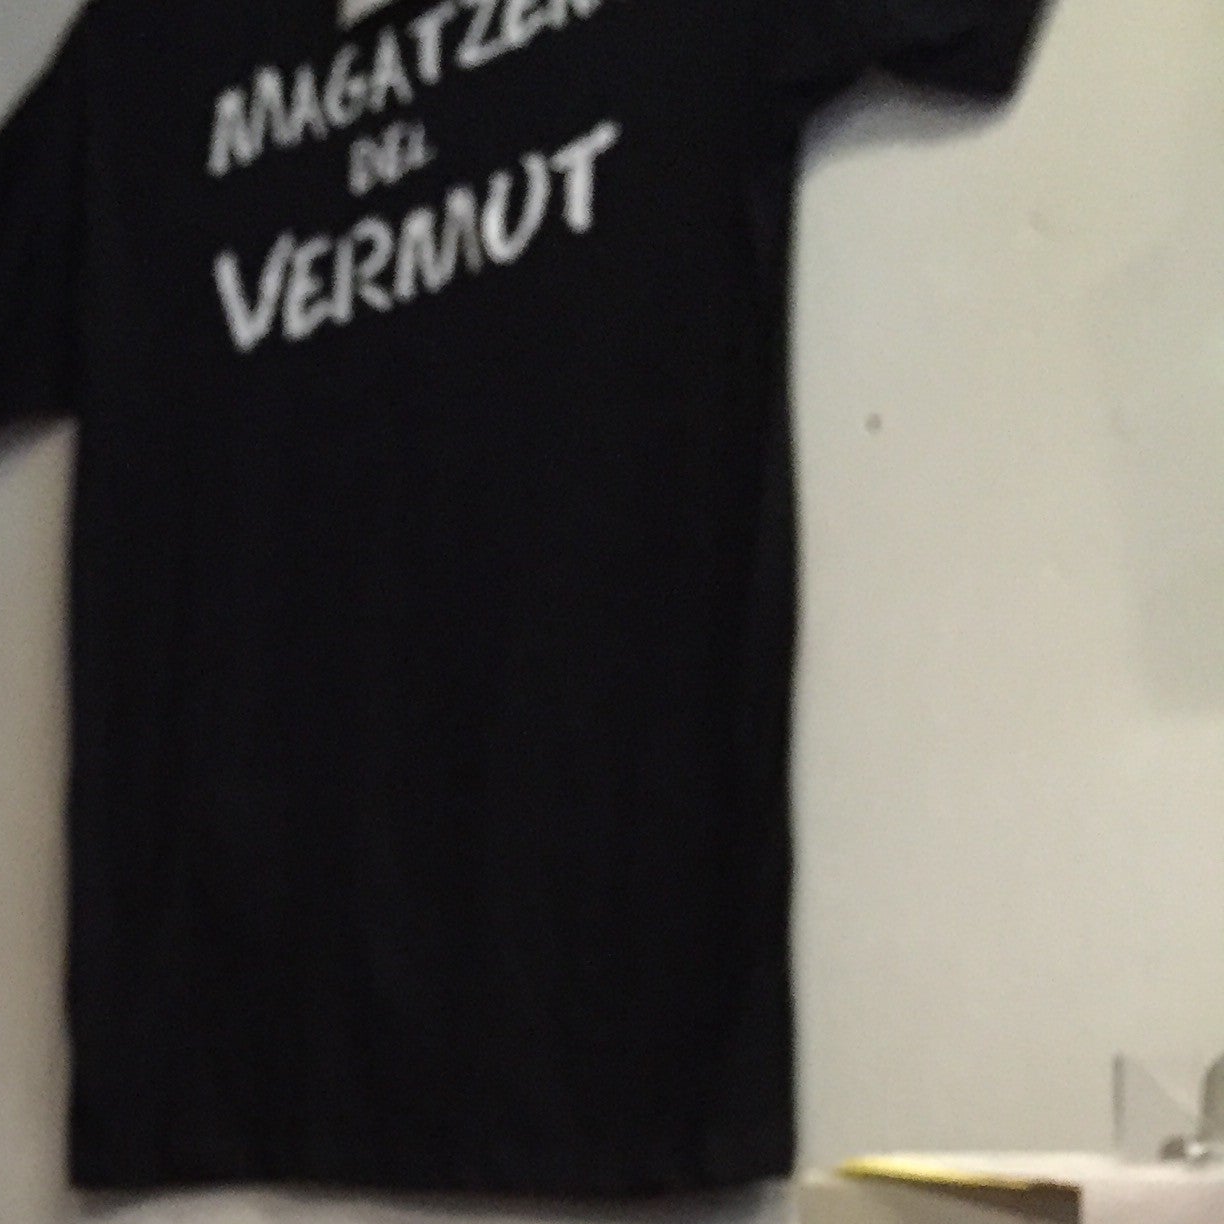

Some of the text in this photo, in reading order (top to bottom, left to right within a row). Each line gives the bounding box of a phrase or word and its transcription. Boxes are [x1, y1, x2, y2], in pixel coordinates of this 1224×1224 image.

[207, 0, 602, 176] MAGATZE
[347, 119, 436, 196] DEL
[212, 119, 622, 353] VERMUT
